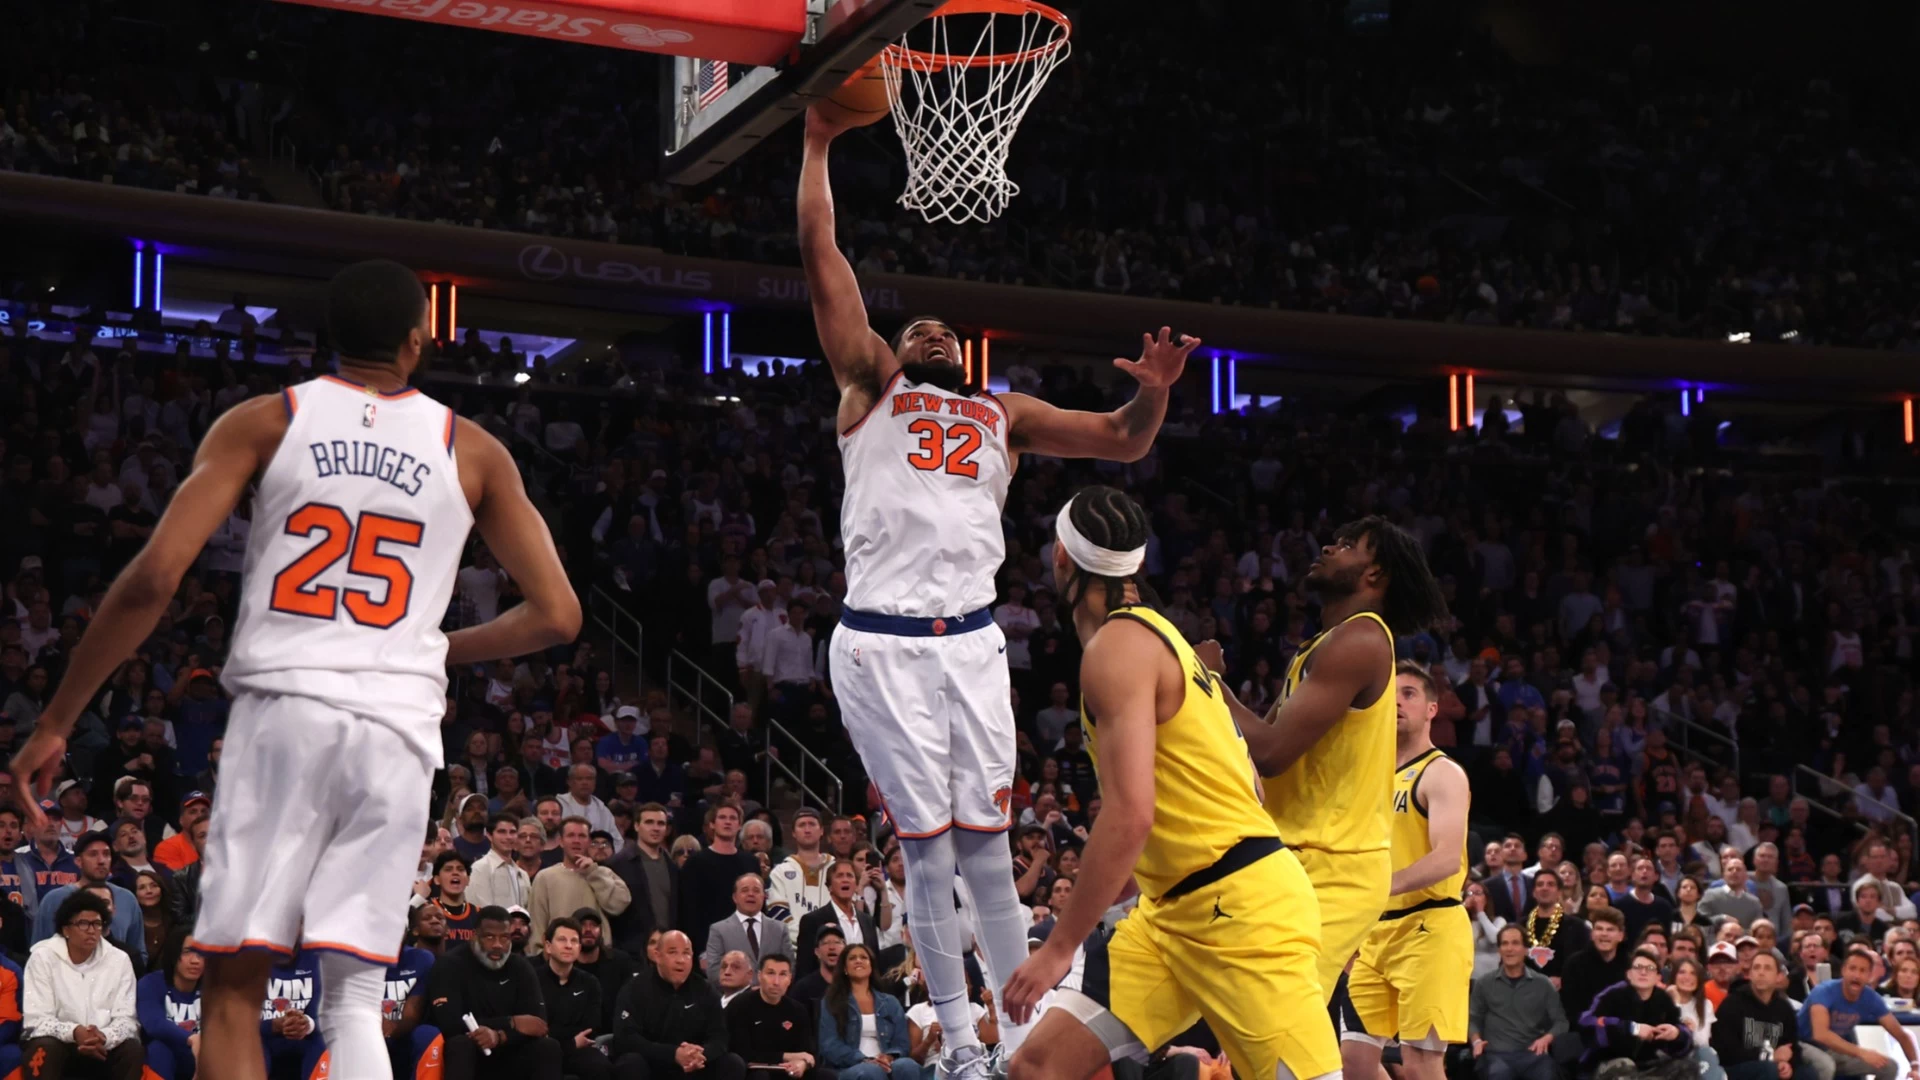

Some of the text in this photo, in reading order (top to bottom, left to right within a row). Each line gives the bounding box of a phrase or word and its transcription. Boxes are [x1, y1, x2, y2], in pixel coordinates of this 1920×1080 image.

[573, 260, 712, 291] LEXUS
[758, 277, 905, 311] SUIT VEL
[892, 392, 1000, 437] NEW YORK
[309, 440, 431, 497] BRIDGES
[908, 418, 983, 480] 32
[269, 501, 426, 630] 25
